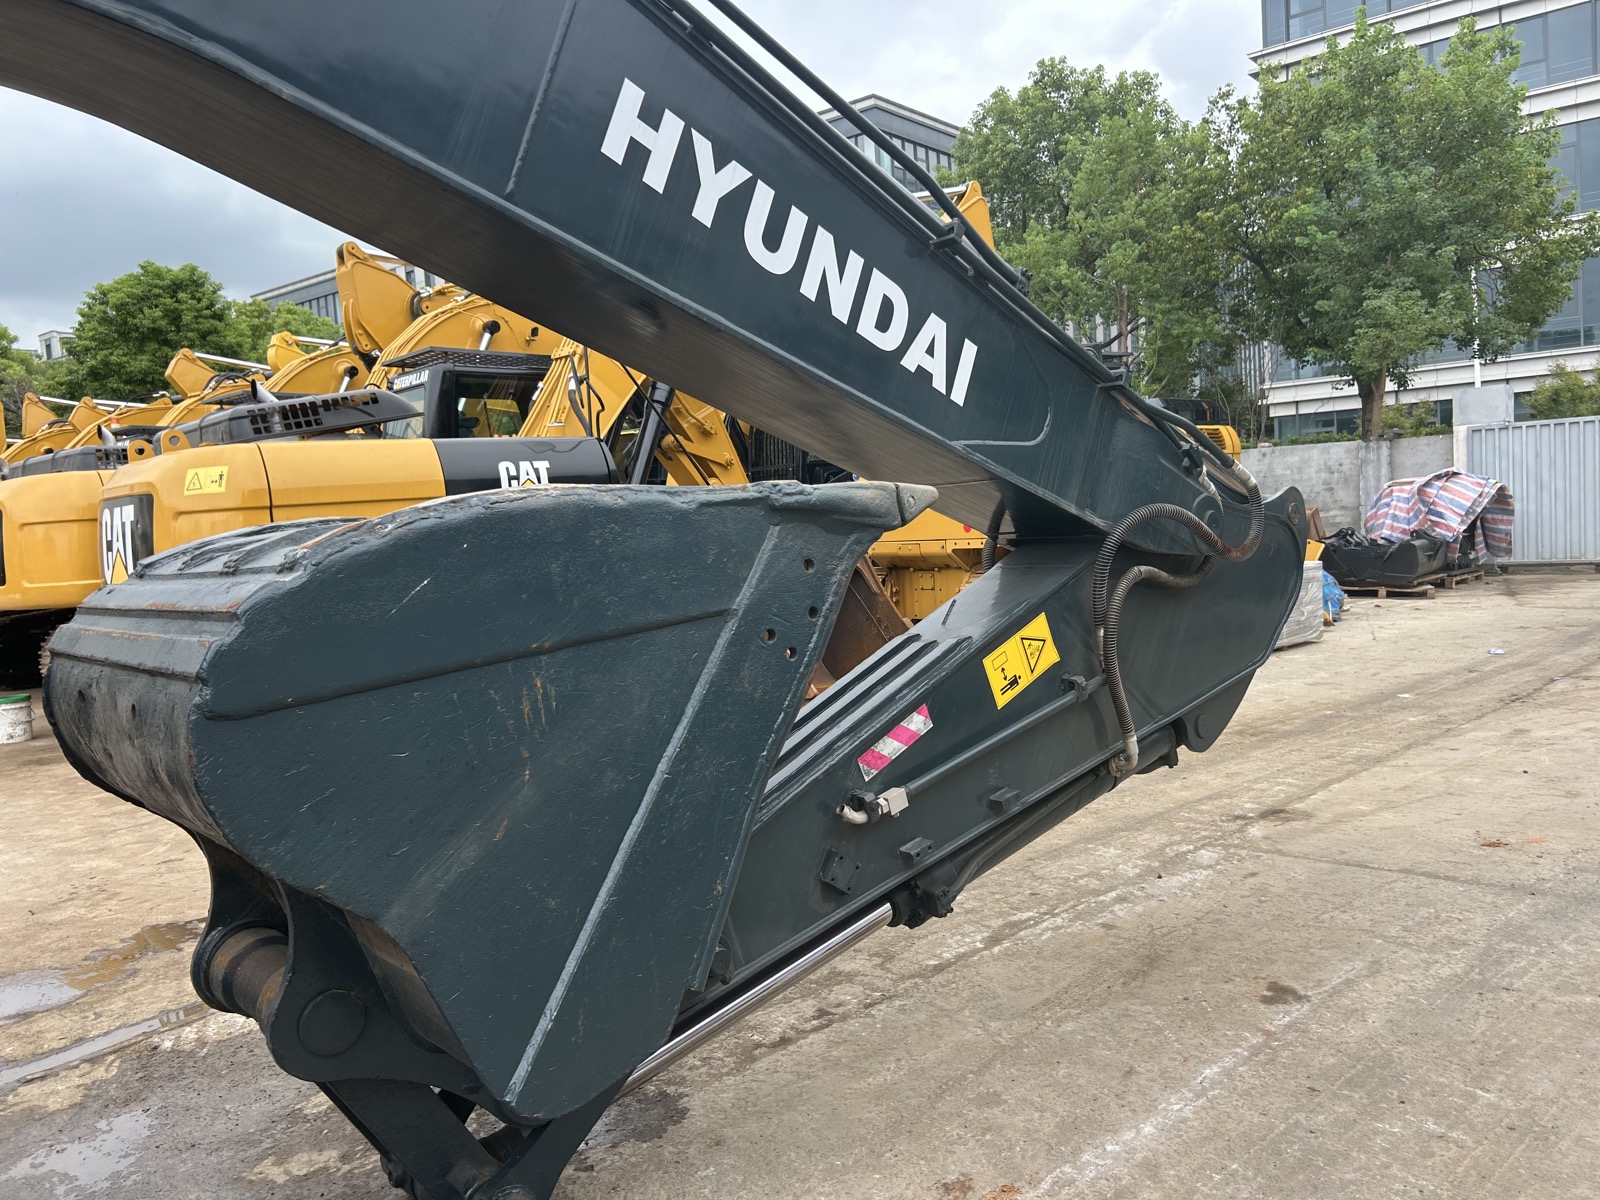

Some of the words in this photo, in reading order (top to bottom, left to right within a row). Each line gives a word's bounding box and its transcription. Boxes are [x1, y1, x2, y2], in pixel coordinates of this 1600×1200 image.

[600, 77, 978, 407] HYUNDAI
[393, 369, 429, 390] CATERPILLAR
[498, 460, 550, 488] CAT
[102, 504, 134, 585] CAT
